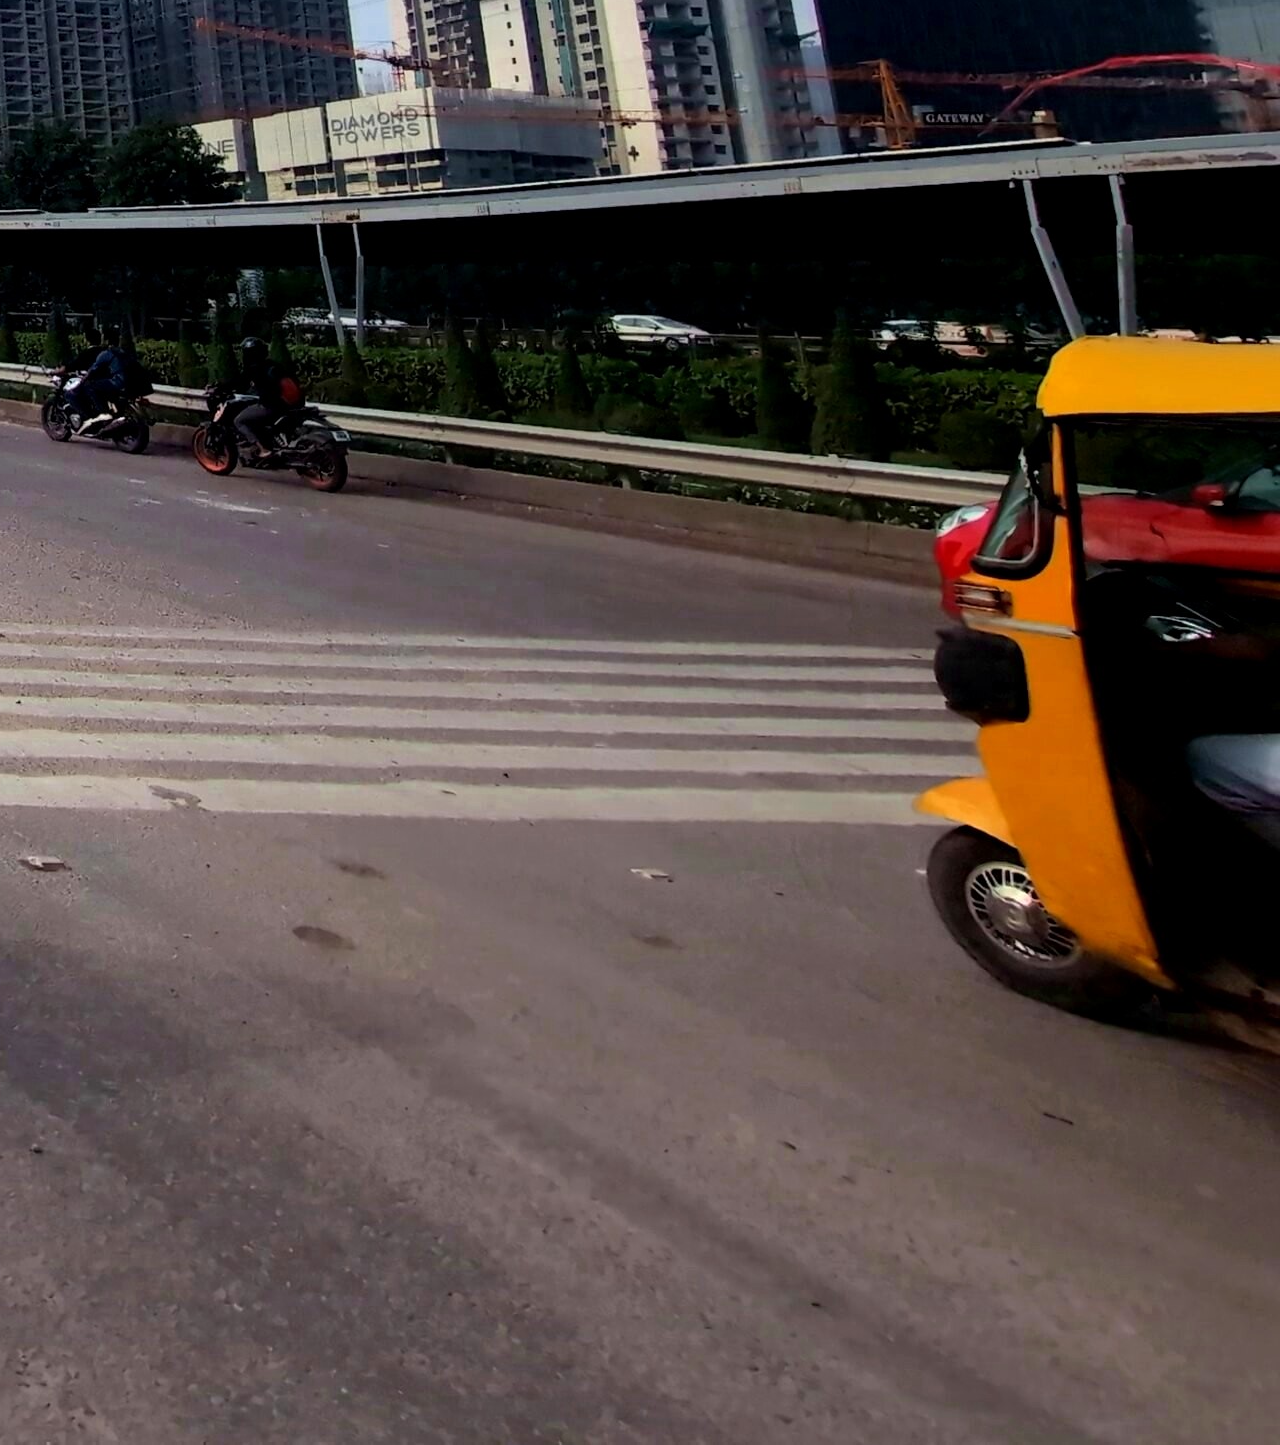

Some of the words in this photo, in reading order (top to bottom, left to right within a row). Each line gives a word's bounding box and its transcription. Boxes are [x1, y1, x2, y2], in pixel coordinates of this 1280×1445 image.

[331, 107, 418, 132] DIAMOND
[926, 113, 984, 123] GATEWAY
[333, 123, 421, 146] TOWERS
